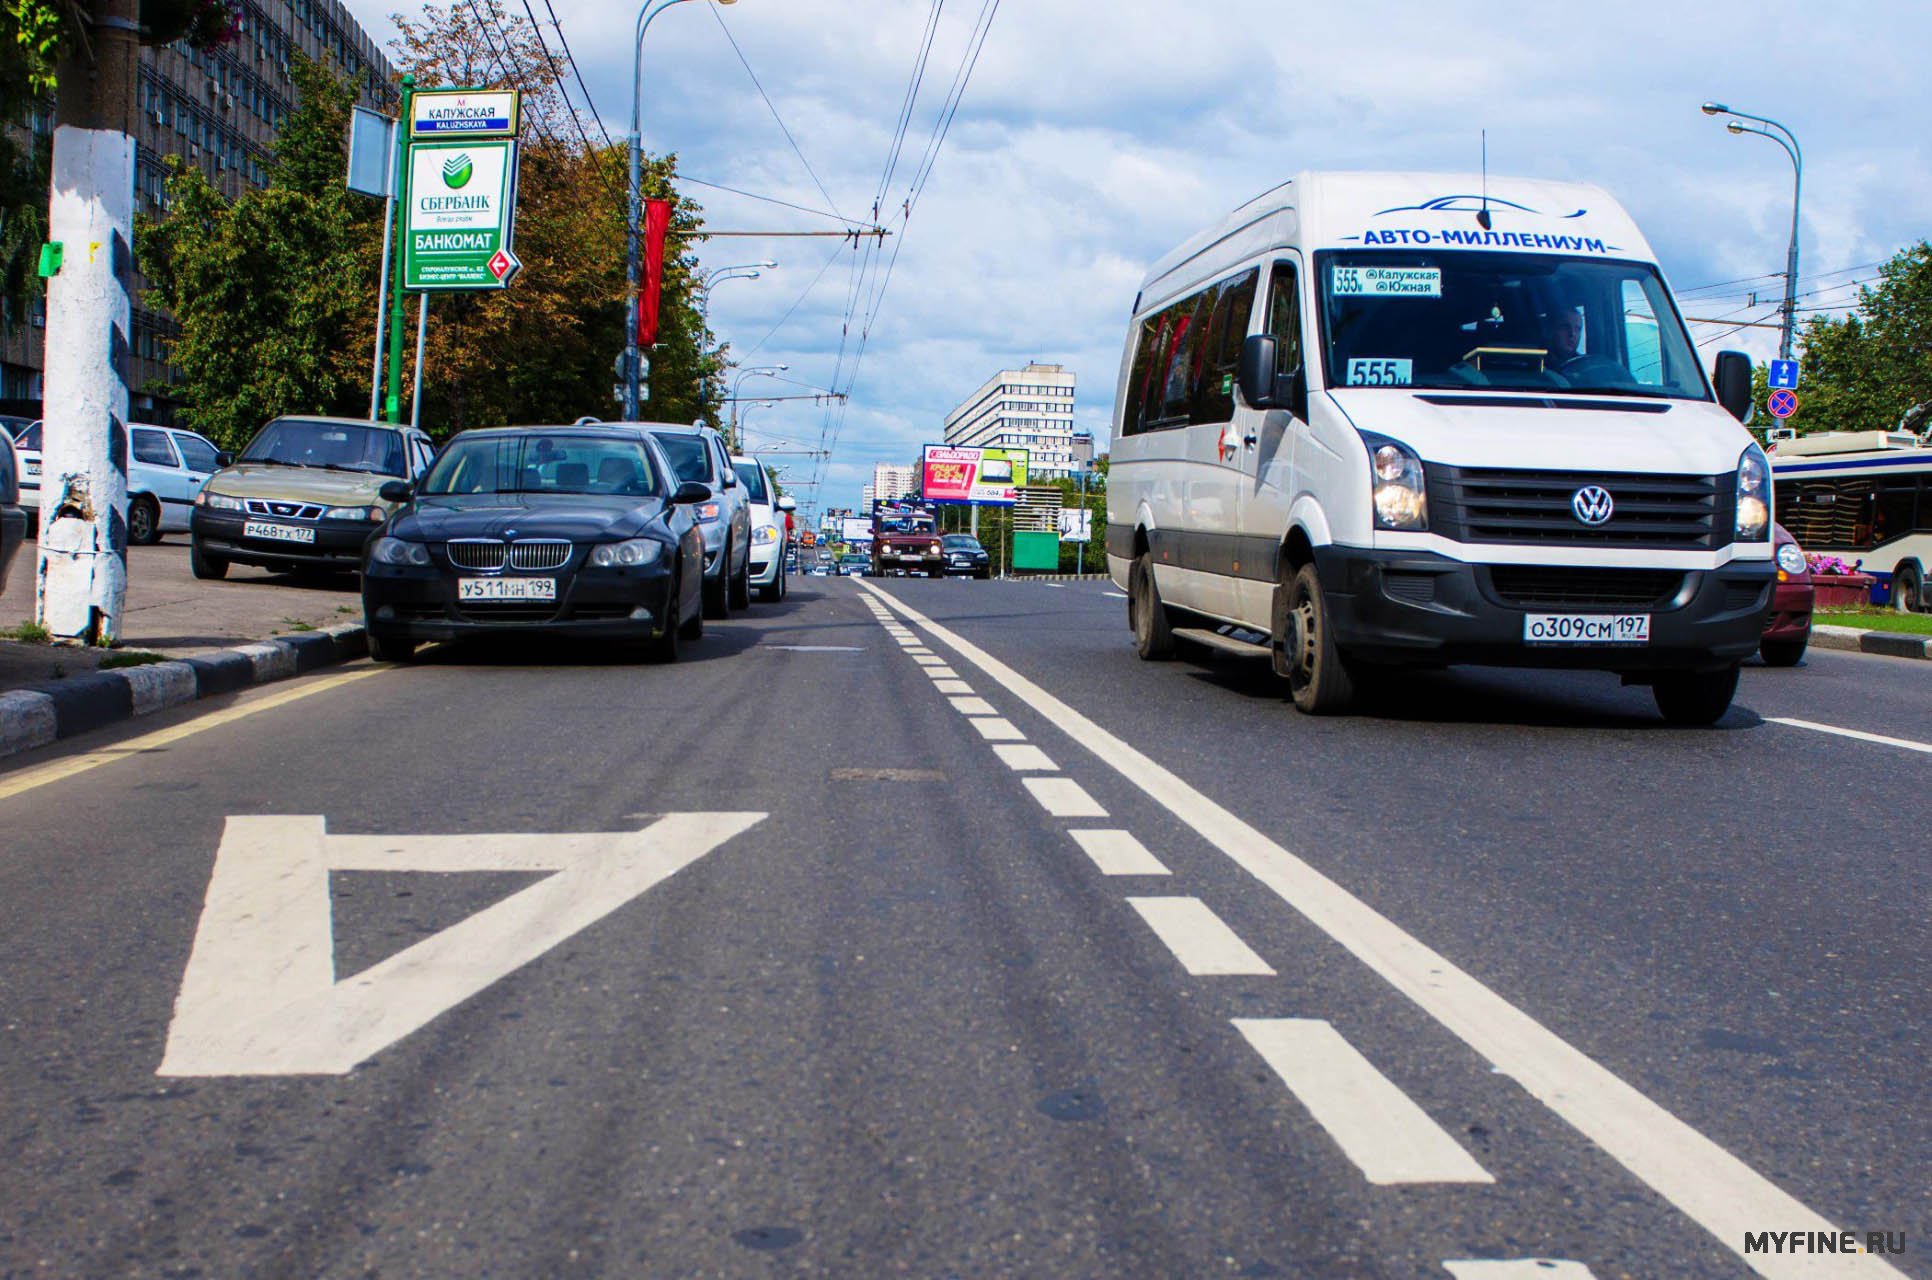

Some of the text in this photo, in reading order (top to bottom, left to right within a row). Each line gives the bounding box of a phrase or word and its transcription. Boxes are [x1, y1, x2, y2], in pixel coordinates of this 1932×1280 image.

[428, 107, 496, 120] КАЛУЖСКАЯ
[436, 120, 487, 129] KALUZHSKAYA
[420, 195, 491, 211] СБЕРБАНК
[415, 233, 493, 250] БАНКОМАТ
[1364, 229, 1607, 253] АВТО-МИЛЛЕНИУМ
[1378, 269, 1439, 281] Калужская
[1389, 281, 1431, 293] Южная
[1616, 617, 1645, 633] 197
